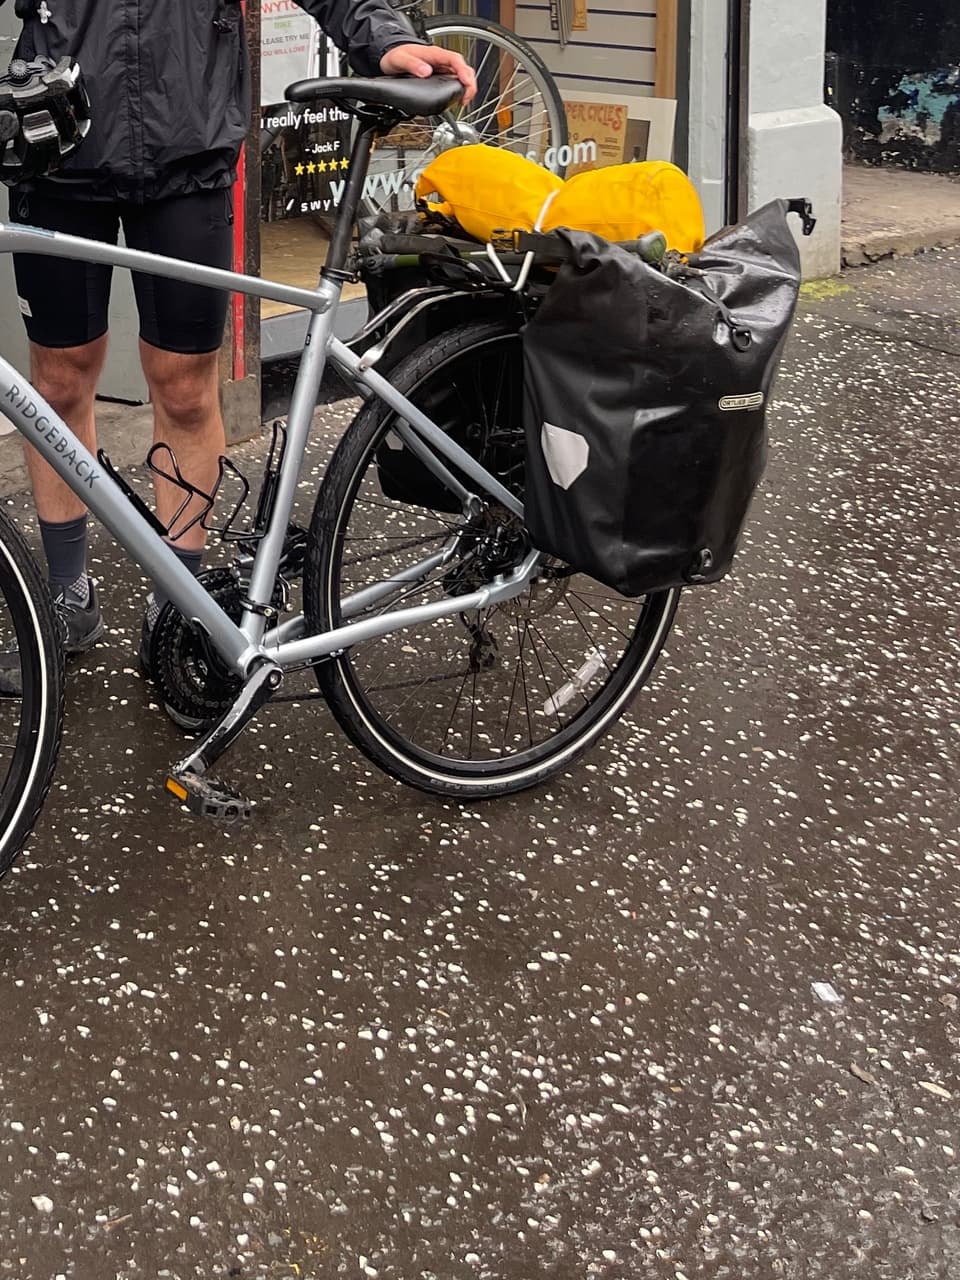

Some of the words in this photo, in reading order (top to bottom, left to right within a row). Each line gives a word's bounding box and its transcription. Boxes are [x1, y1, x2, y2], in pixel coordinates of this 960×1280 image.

[266, 111, 302, 130] really
[303, 107, 327, 124] feel
[311, 141, 333, 154] Jack
[4, 383, 101, 490] RIDGEBACK
